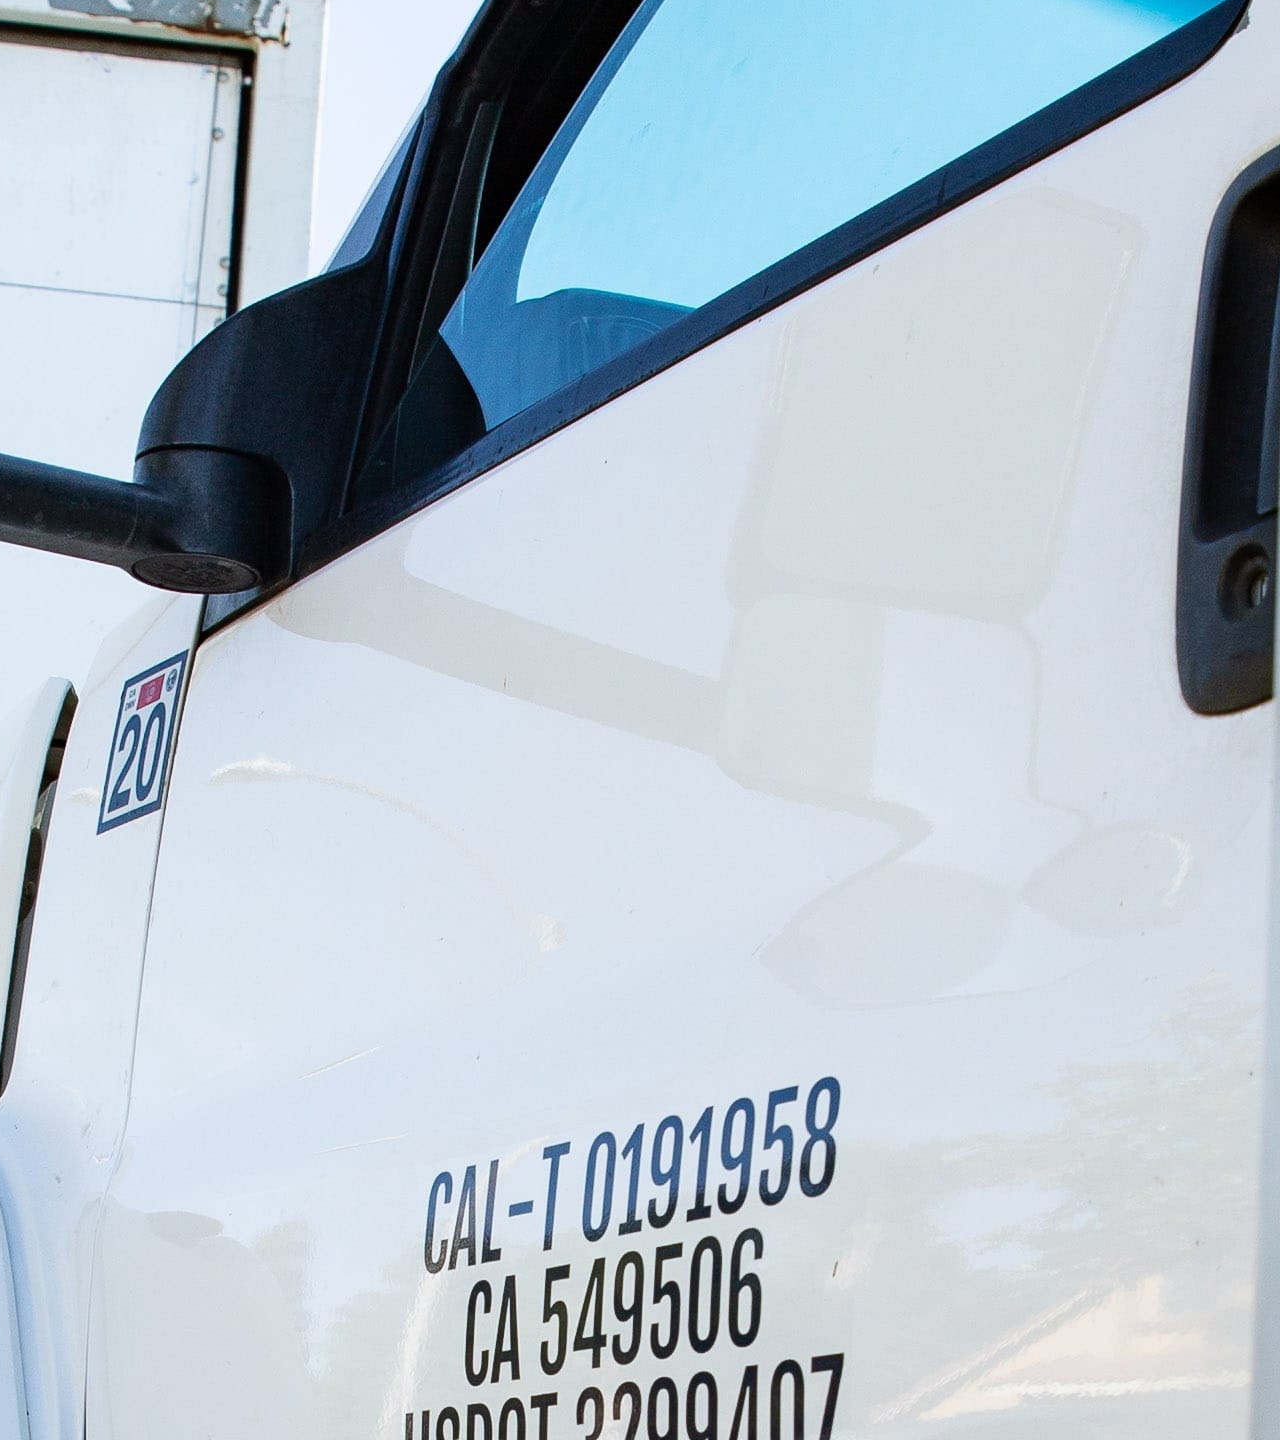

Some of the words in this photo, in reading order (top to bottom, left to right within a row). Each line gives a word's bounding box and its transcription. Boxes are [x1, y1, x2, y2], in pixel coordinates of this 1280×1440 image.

[108, 701, 166, 813] 20
[424, 1142, 570, 1274] CAL-T
[582, 1077, 841, 1243] 0191958
[464, 1275, 521, 1386] CA
[540, 1228, 764, 1375] 549506
